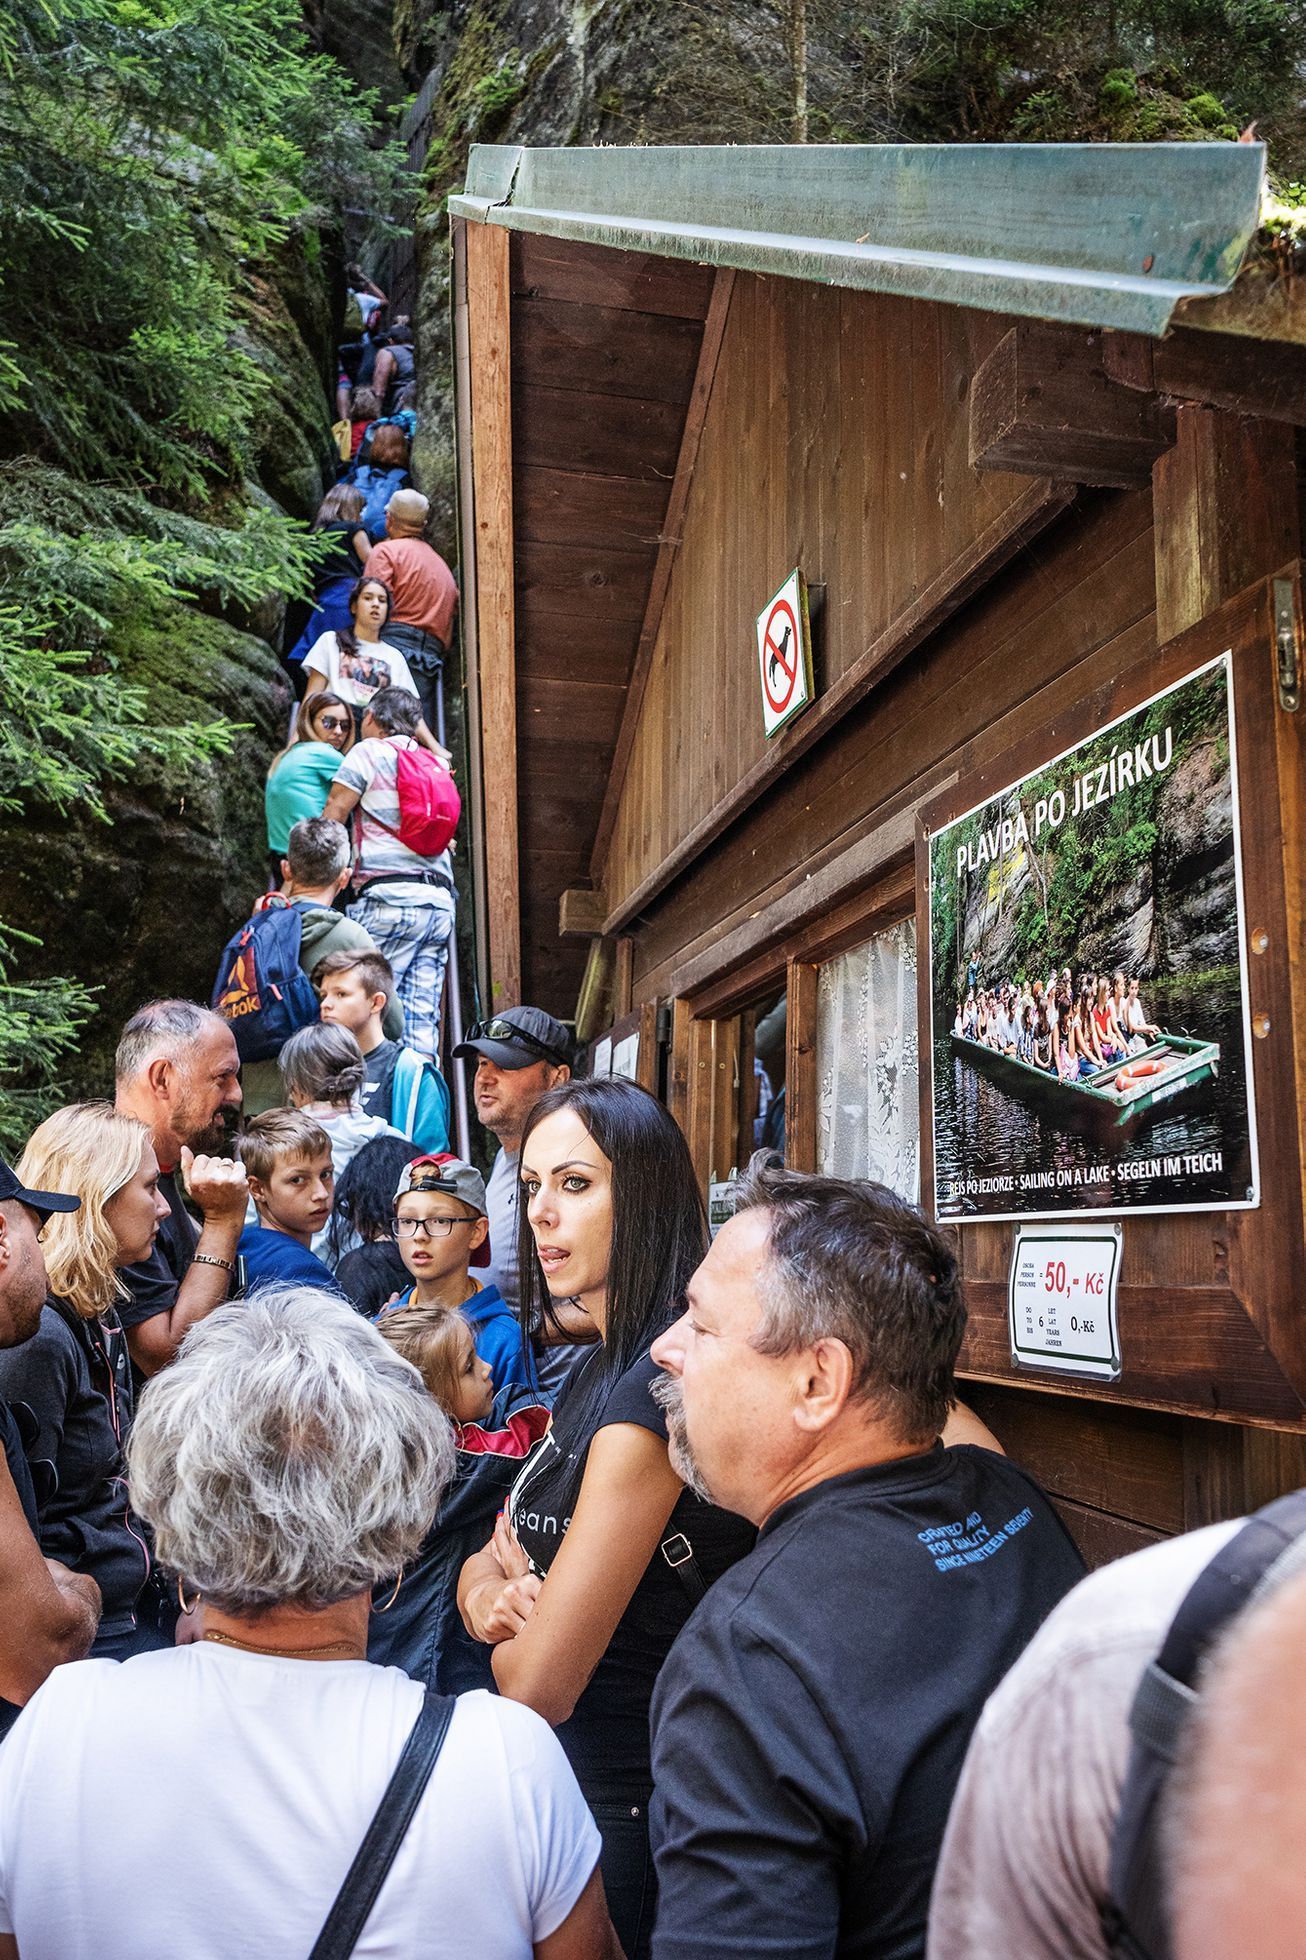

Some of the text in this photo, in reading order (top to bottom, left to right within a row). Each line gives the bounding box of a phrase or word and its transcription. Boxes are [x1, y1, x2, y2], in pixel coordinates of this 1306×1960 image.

[957, 726, 1173, 878] PLAVBA PO JEZÍRKU
[978, 1175, 1015, 1193] JEZIORZE
[1020, 1171, 1055, 1190] SAILING
[1056, 1168, 1072, 1187] ON
[1073, 1168, 1083, 1185] A
[1084, 1165, 1110, 1184] LAKE
[1117, 1159, 1160, 1181] SEGELN
[1163, 1157, 1181, 1177] IM
[1182, 1152, 1223, 1175] TEICH
[1085, 1272, 1105, 1295] Kč
[1038, 1316, 1044, 1328] 6
[518, 1508, 572, 1534] eans
[927, 1524, 991, 1556] FOR QUALITY
[934, 1553, 968, 1573] SINCE
[962, 1530, 1009, 1564] NINETEEN
